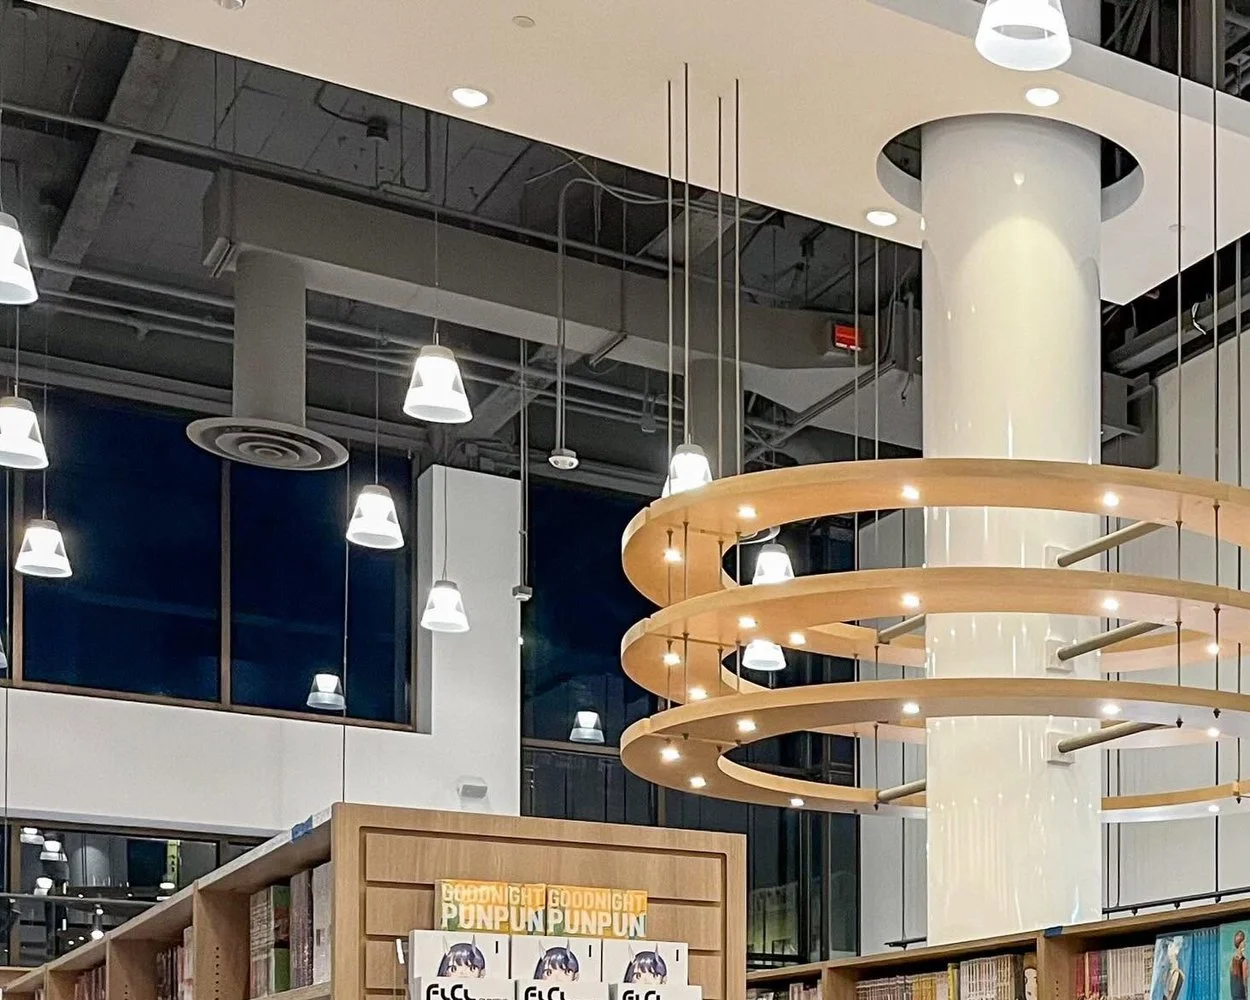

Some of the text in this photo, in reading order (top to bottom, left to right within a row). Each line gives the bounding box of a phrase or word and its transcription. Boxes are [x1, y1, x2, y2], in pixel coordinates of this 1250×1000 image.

[441, 882, 546, 905] GOODNIGHT
[549, 887, 647, 913] GOODNIGHT
[440, 902, 546, 934] PUNPUN
[548, 907, 647, 937] PUNPUN
